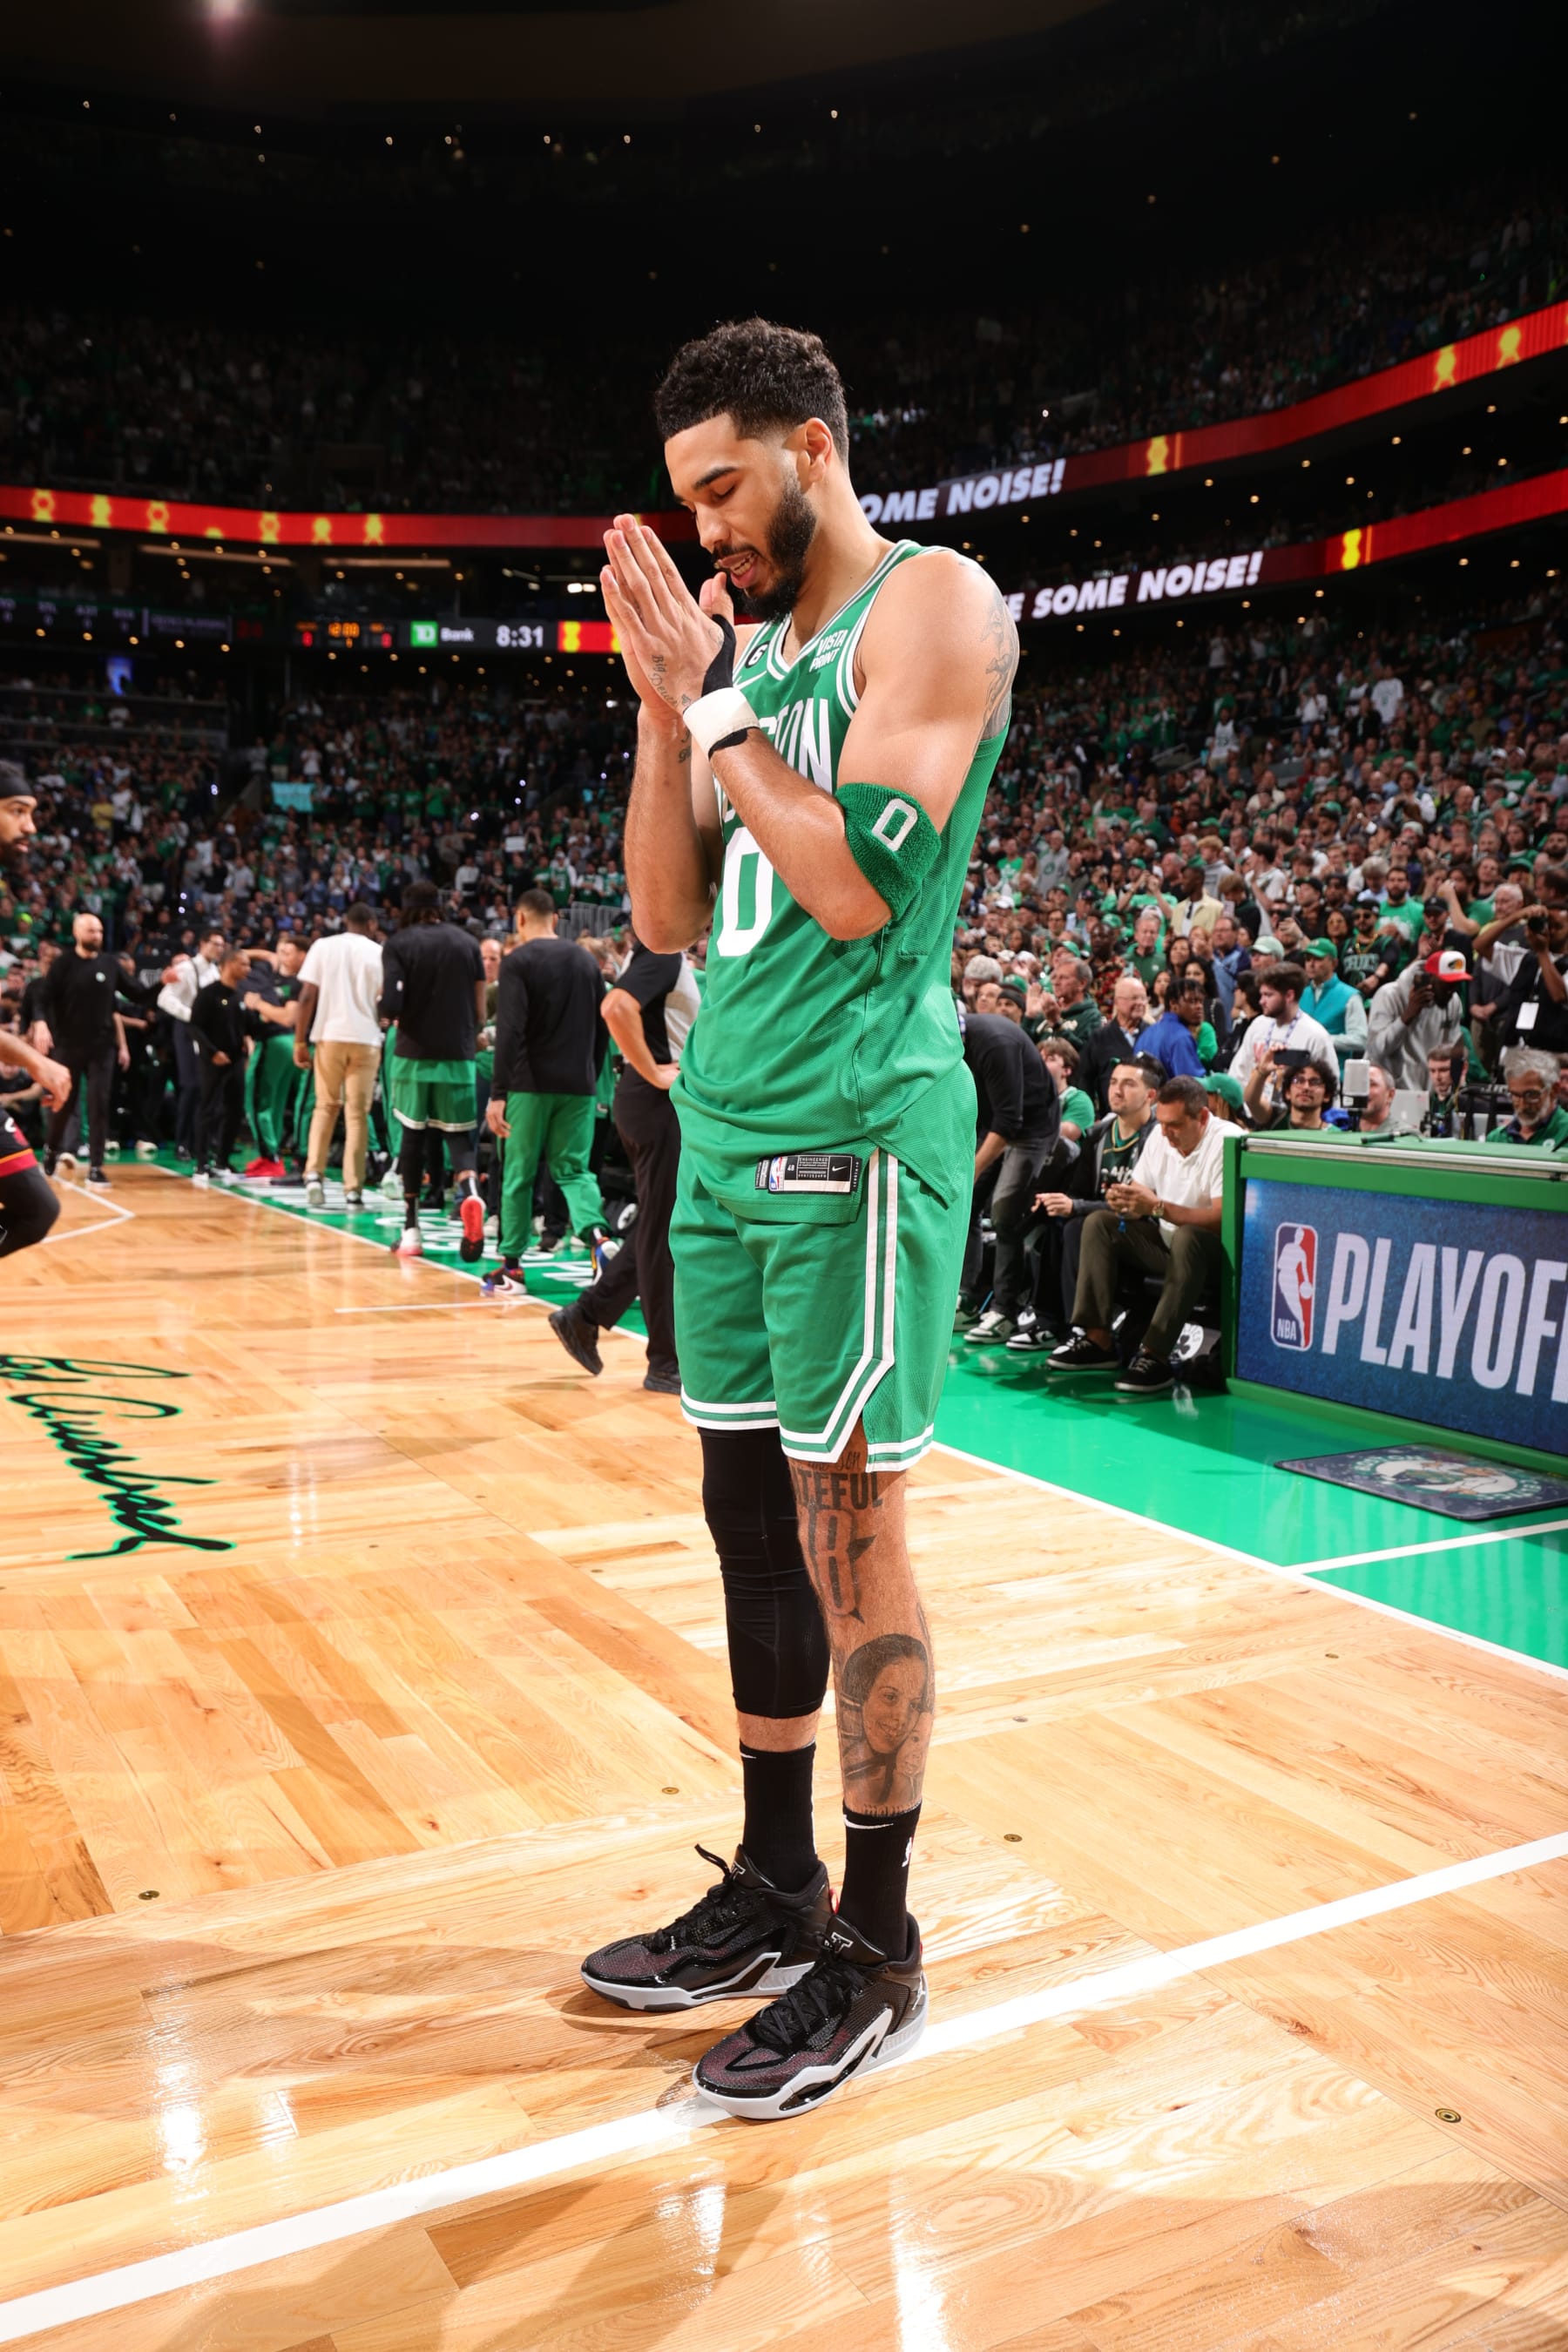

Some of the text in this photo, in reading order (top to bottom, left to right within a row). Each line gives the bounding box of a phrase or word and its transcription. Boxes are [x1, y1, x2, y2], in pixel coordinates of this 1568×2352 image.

[859, 459, 1065, 523] OME NOISE!
[1031, 575, 1129, 618] SOME
[1137, 551, 1263, 603] NOISE!
[415, 625, 475, 644] TD Bank
[496, 625, 544, 648] 8:31
[816, 629, 848, 658] VISTA
[747, 644, 768, 666] 6
[808, 648, 840, 672] PRINT
[872, 798, 918, 852] 0
[716, 826, 774, 956] 0
[1277, 1317, 1297, 1342] NBA
